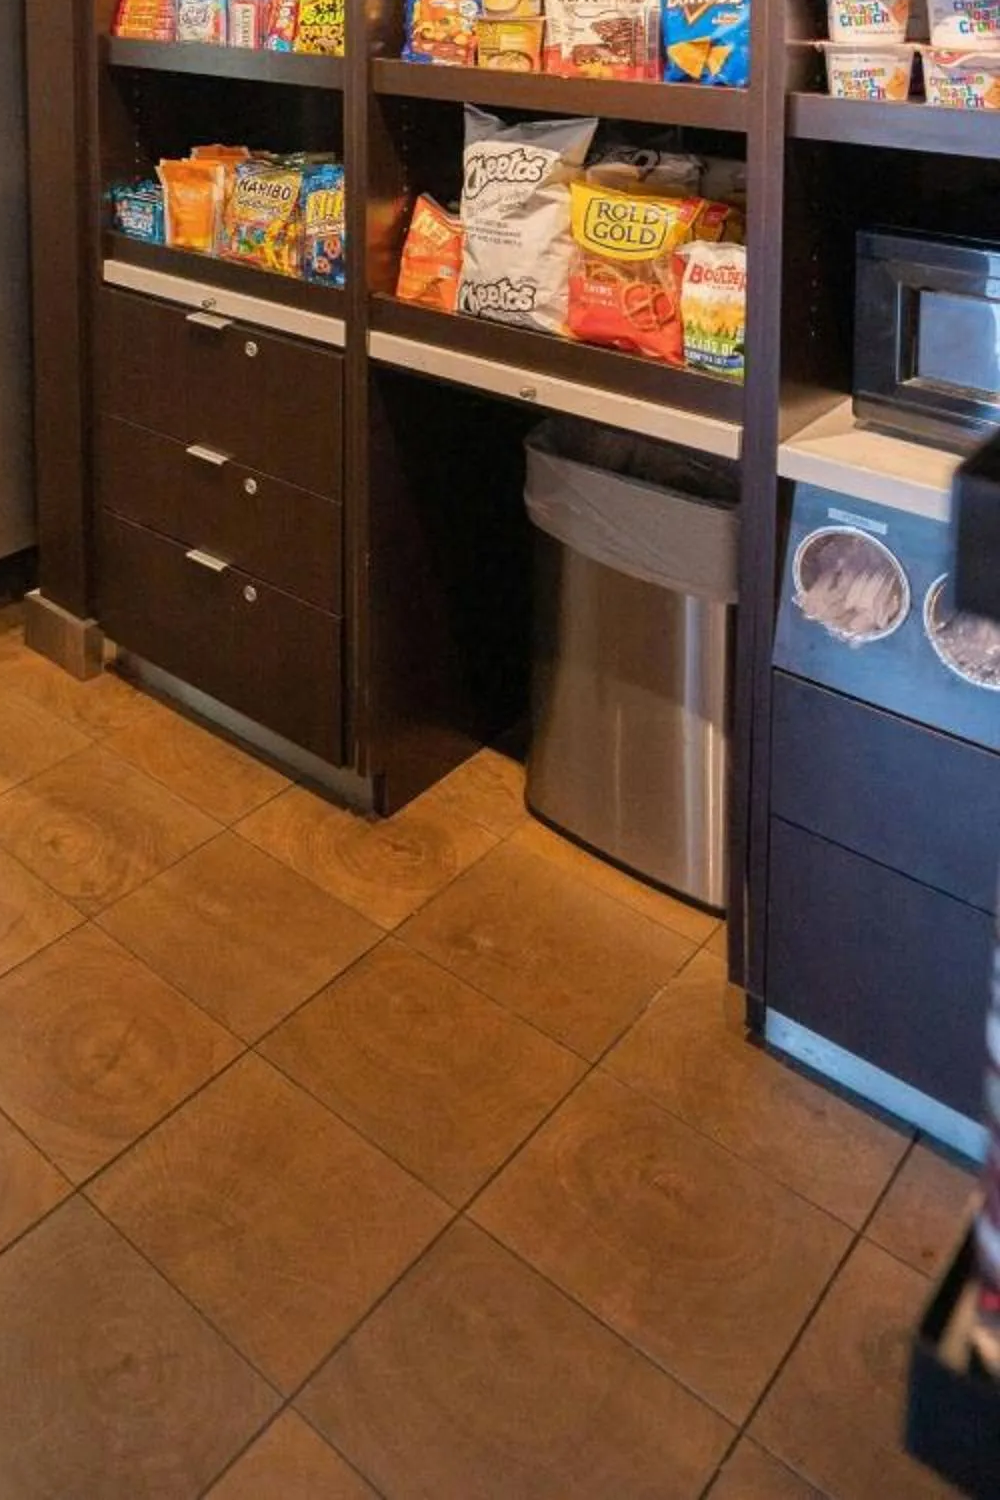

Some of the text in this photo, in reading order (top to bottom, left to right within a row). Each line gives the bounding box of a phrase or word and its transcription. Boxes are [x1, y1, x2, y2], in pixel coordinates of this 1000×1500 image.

[839, 10, 890, 28] Crunch
[464, 149, 546, 199] Cheetos
[238, 178, 292, 201] HARIBO
[598, 202, 657, 226] ROLD
[592, 222, 657, 246] GOLD
